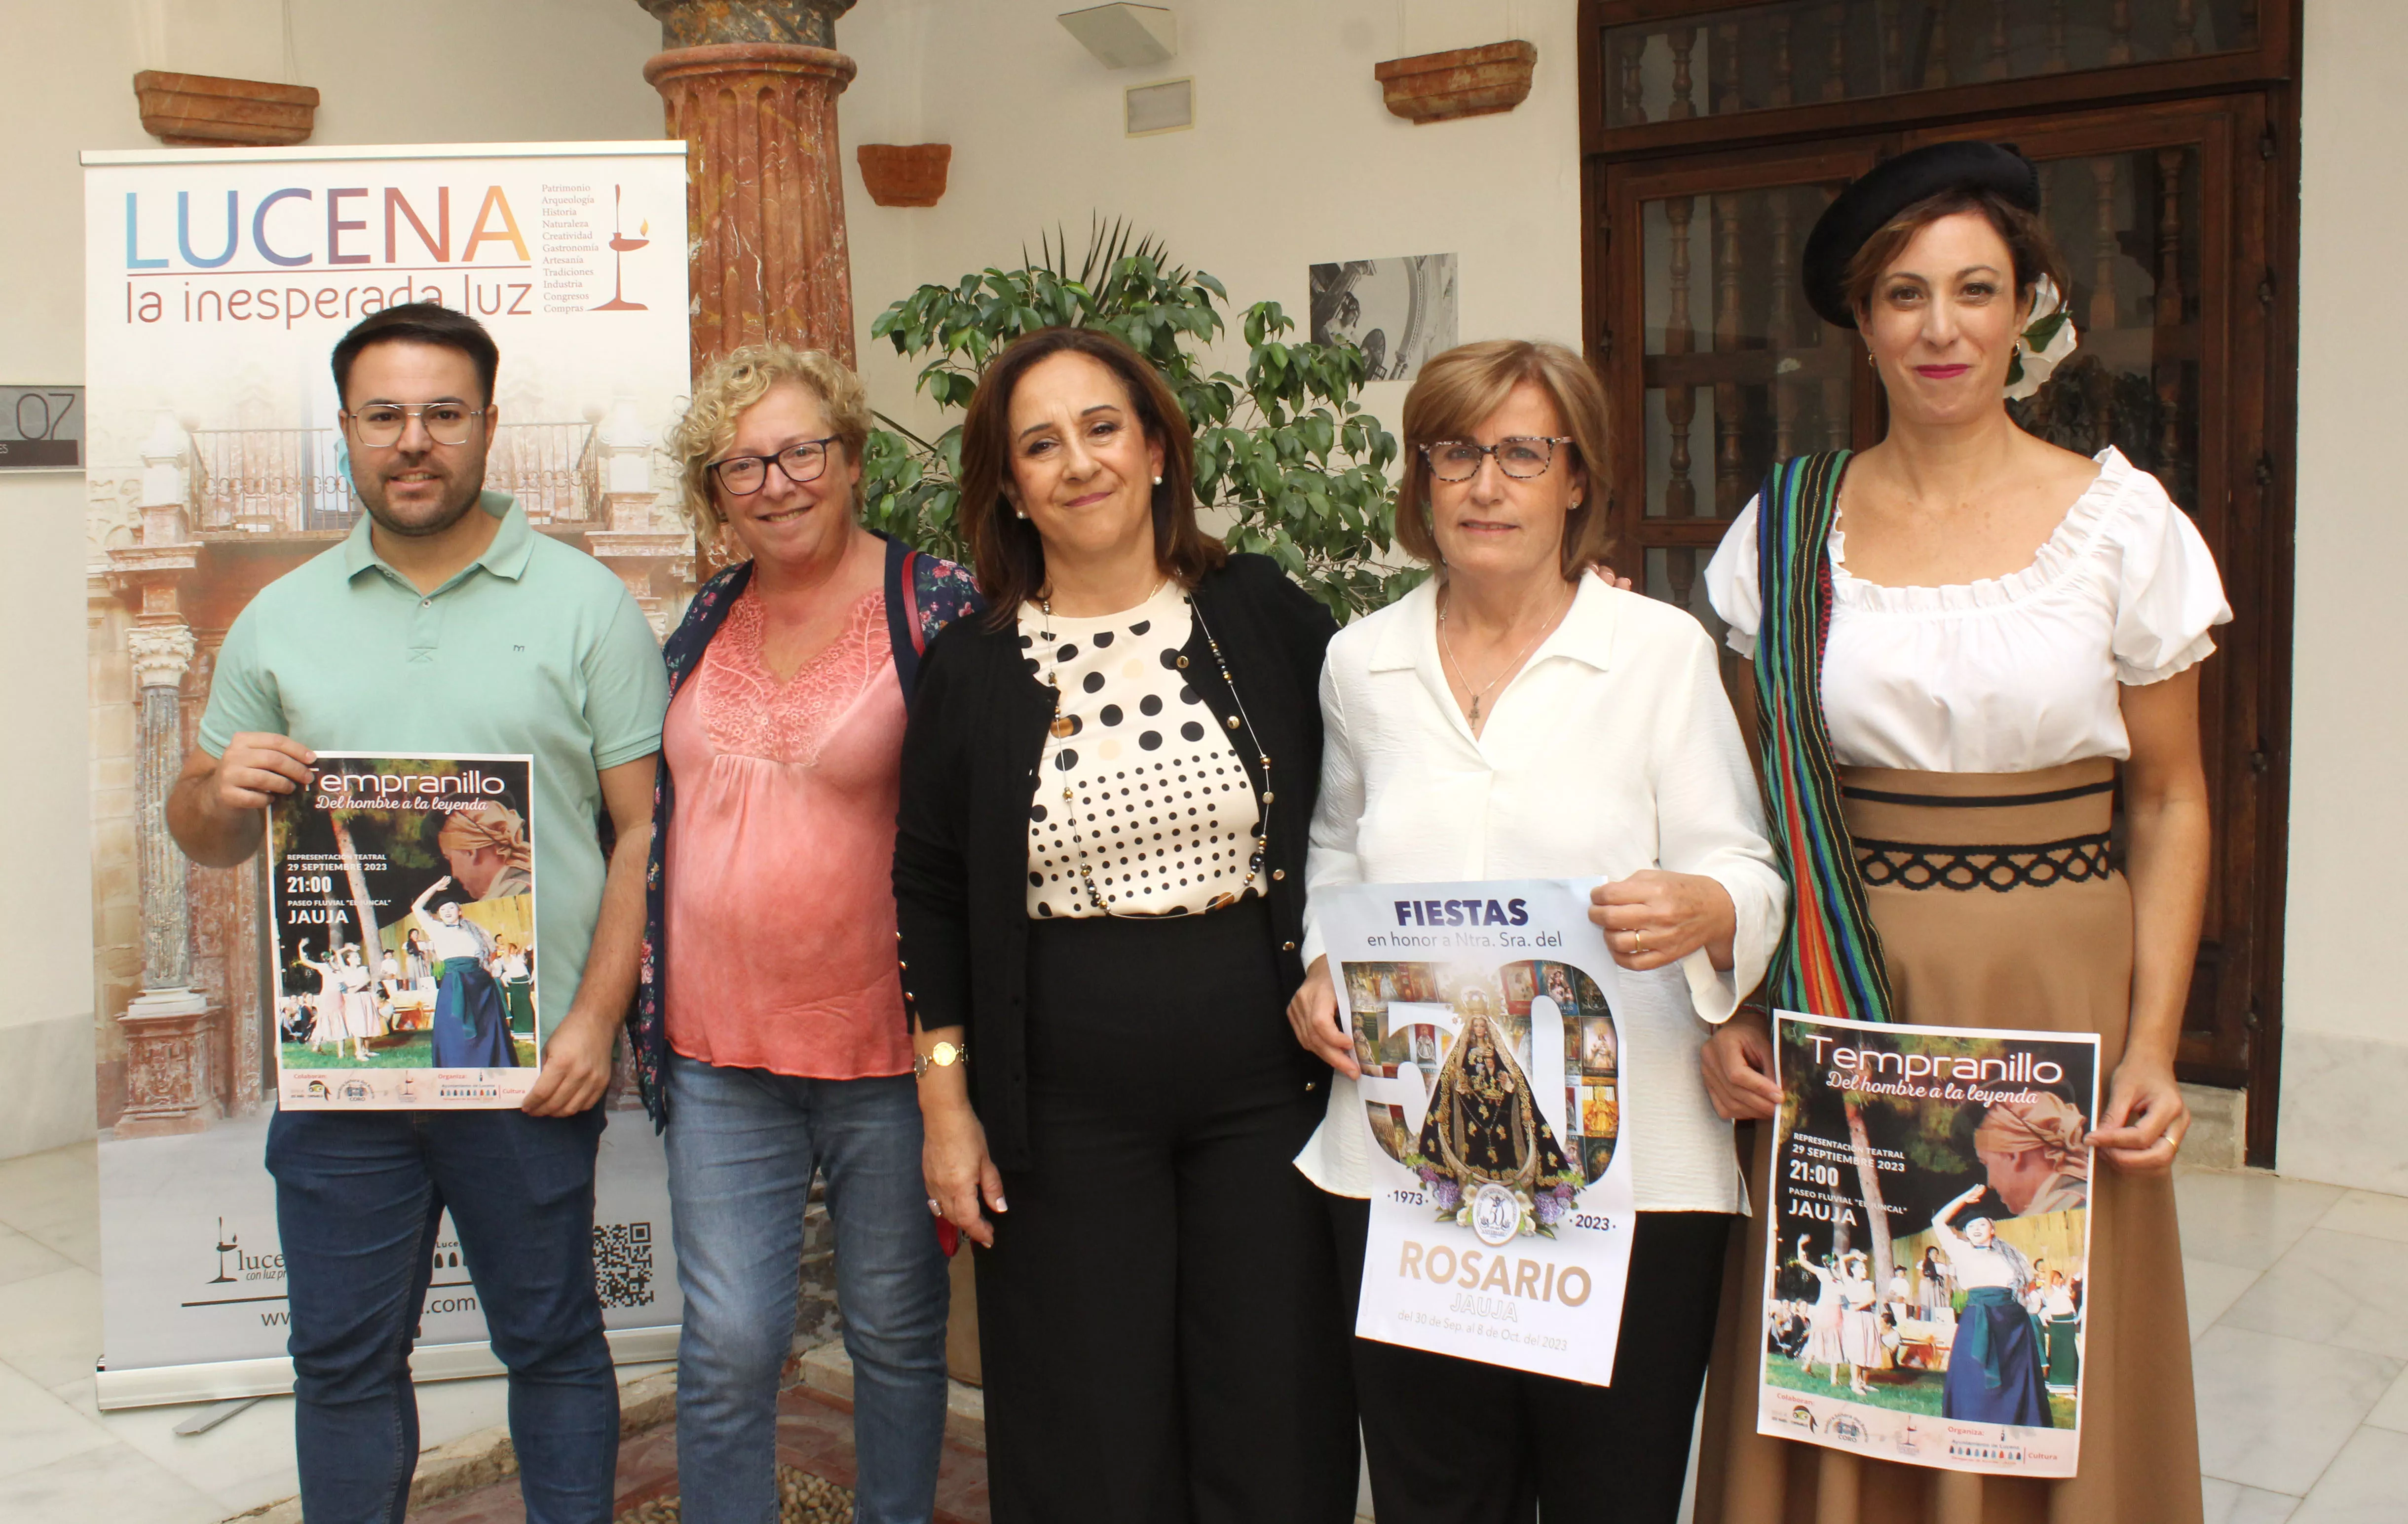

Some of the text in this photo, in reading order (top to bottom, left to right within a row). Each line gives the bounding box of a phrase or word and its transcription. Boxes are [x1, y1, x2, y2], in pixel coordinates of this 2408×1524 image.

[542, 184, 591, 192] Patrimonio
[542, 194, 595, 206] Arqueología
[126, 186, 531, 268] LUCENA
[542, 219, 589, 228] Naturaleza
[543, 231, 593, 240] Creatividad
[543, 242, 599, 252] Gastronomía
[543, 256, 584, 264] Artesanía
[543, 267, 594, 276] Tradiciones
[544, 280, 583, 288] Industria
[127, 274, 532, 330] la inesperada luz
[544, 292, 589, 303] Congresos
[544, 304, 584, 314] Compras
[17, 393, 75, 440] 07
[315, 795, 344, 809] Del
[346, 796, 400, 809] hombre
[414, 797, 430, 809] la
[432, 797, 489, 815] leyenda
[287, 876, 332, 893] 21:00
[288, 910, 349, 924] JAUJA
[1394, 898, 1528, 926] FIESTAS
[1367, 931, 1562, 948] en honor a Ntra. Sra. del
[1805, 1034, 2063, 1084] Tempranillo
[1826, 1071, 2038, 1108] Del hombre a la leyenda
[1792, 1143, 1905, 1172] 29 SEPTIEMBRE 2023
[1866, 1147, 1905, 1159] TEATRAL
[1790, 1159, 1839, 1187] 21:00
[1393, 1190, 1424, 1206] 1973
[1789, 1186, 1816, 1198] PASEO
[1818, 1192, 1853, 1206] FLUVIAL
[1788, 1198, 1857, 1226] JAUJA
[1576, 1214, 1610, 1231] 2023
[247, 1271, 261, 1280] con
[263, 1269, 276, 1279] luz
[1398, 1240, 1592, 1307] ROSARIO
[1450, 1293, 1518, 1323] JAUJA
[1397, 1310, 1568, 1351] del 30 de Sep. al 8 de Oct. del 2023
[1777, 1393, 1815, 1406] Colaboran:
[1838, 1434, 1857, 1443] CORO
[1948, 1426, 1984, 1436] Organiza:
[2028, 1452, 2058, 1460] Cultura
